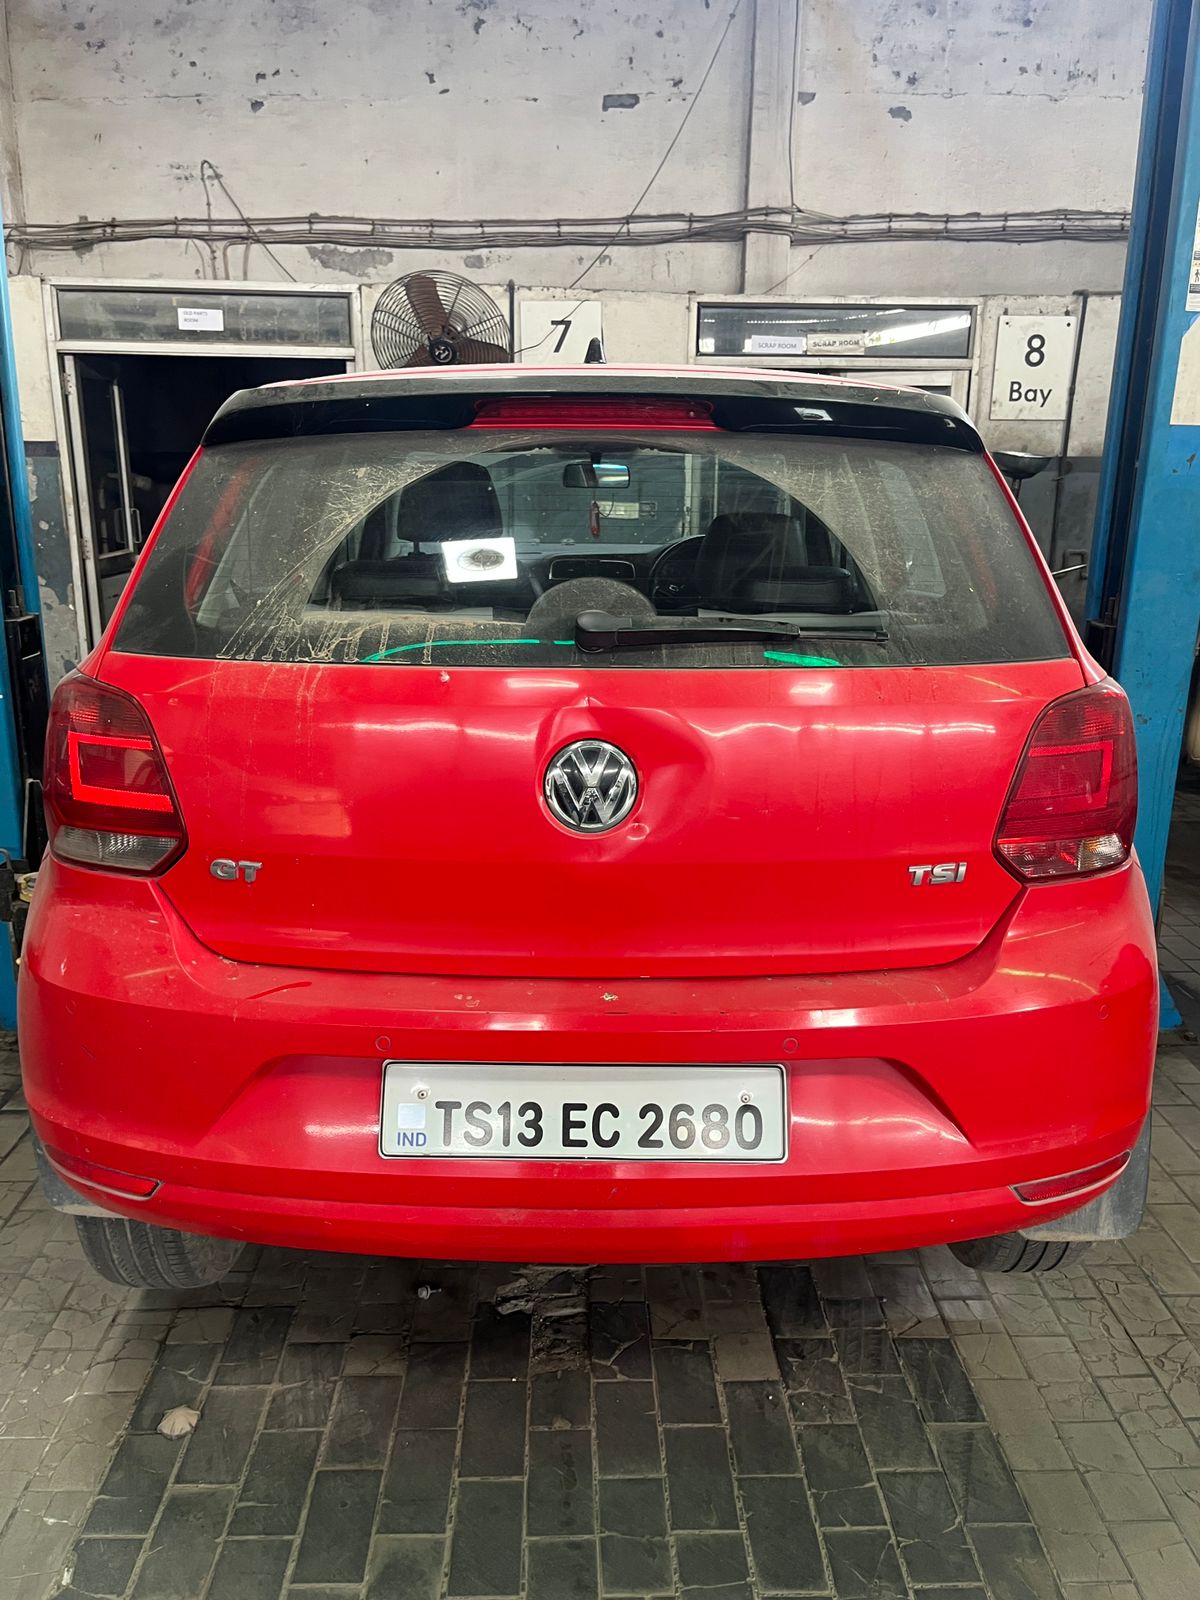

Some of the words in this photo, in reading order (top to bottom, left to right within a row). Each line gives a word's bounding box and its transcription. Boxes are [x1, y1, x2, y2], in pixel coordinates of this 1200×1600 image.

[550, 320, 572, 353] 7
[1024, 333, 1046, 368] 8
[1008, 381, 1053, 408] Bay
[210, 859, 262, 882] GT
[908, 862, 967, 885] TSI
[435, 1101, 544, 1148] TS13
[562, 1103, 620, 1148] EC
[637, 1103, 763, 1150] 2680
[396, 1132, 427, 1147] IND
